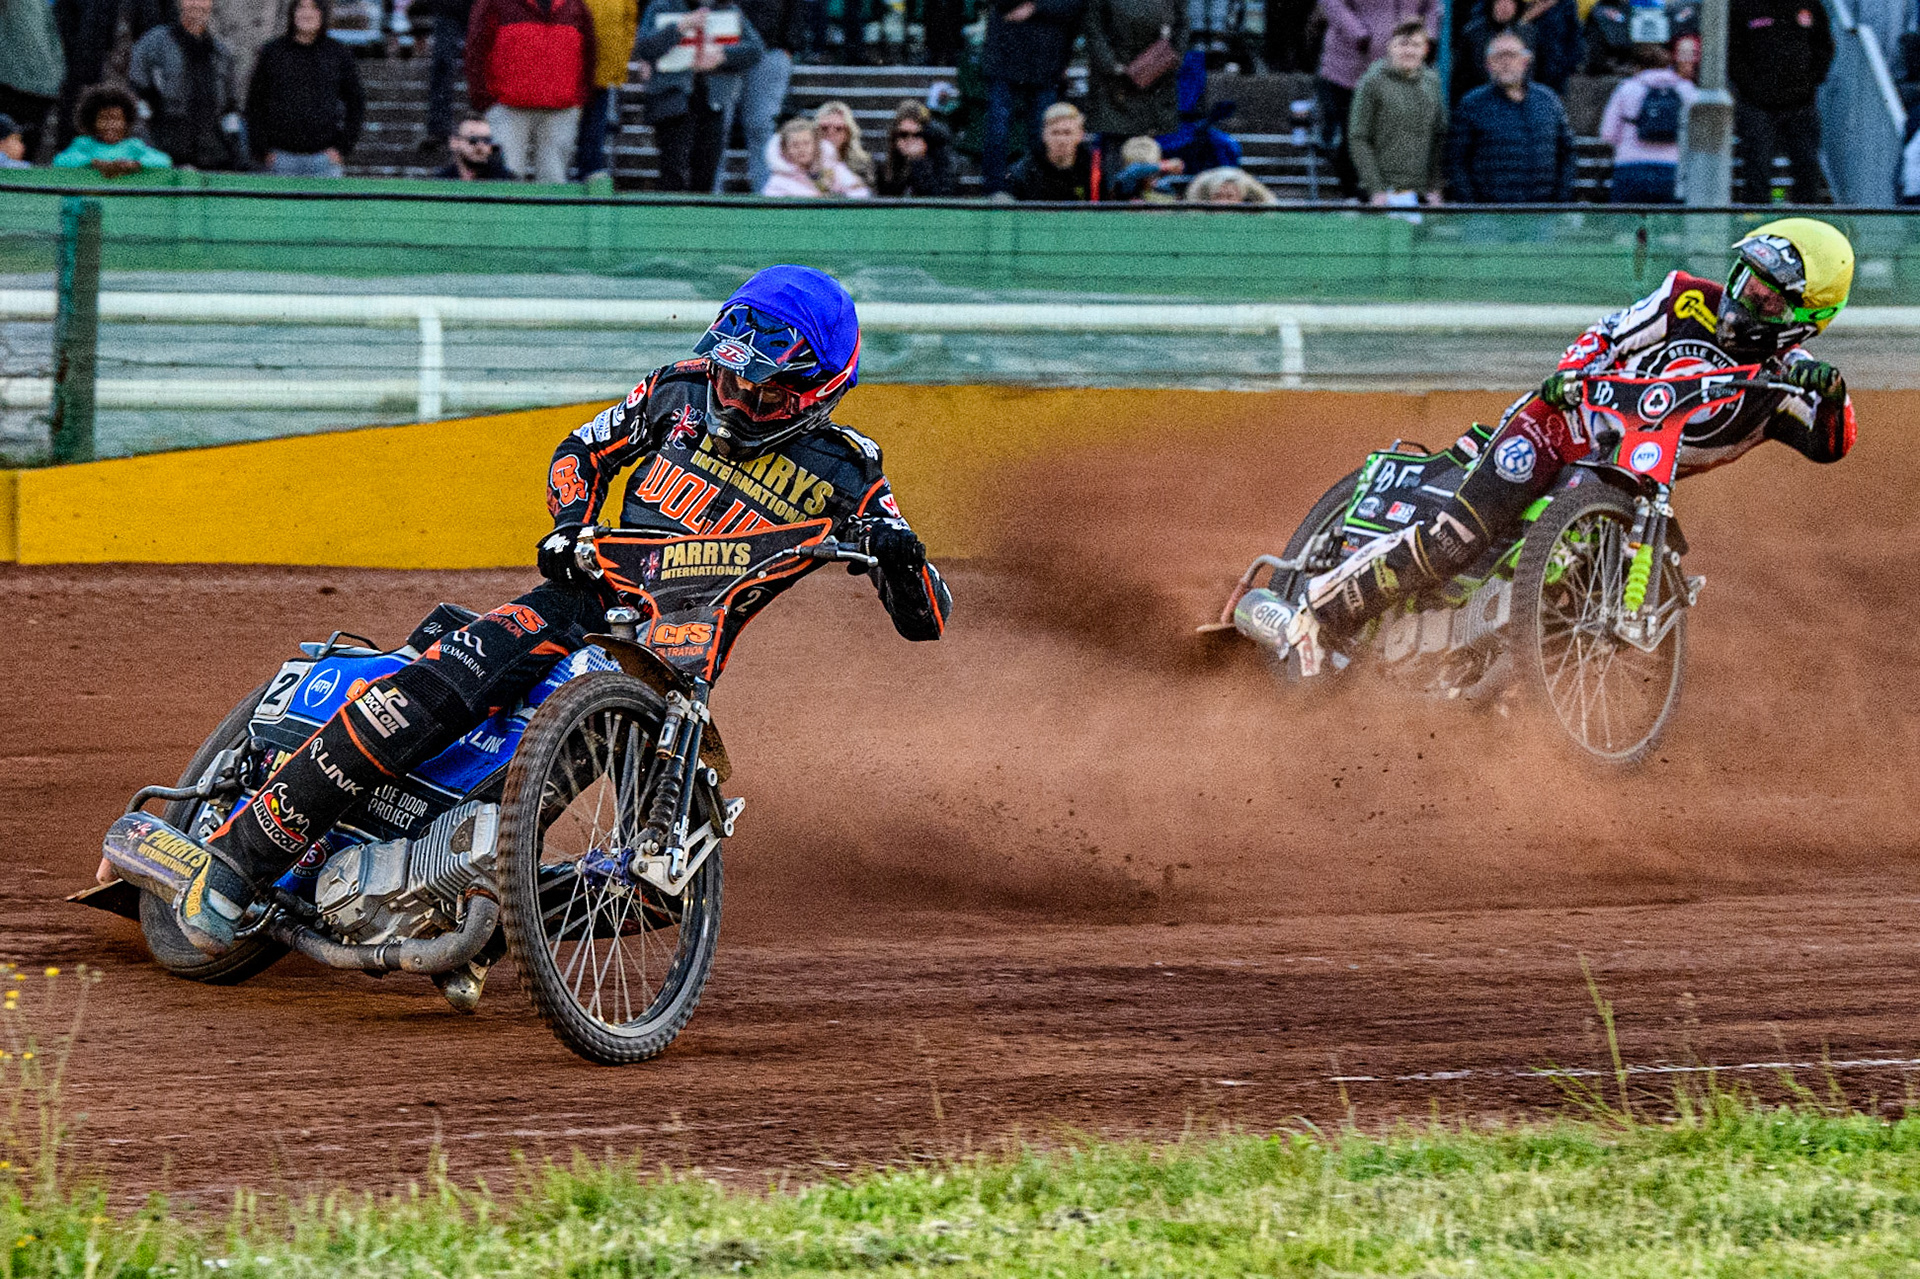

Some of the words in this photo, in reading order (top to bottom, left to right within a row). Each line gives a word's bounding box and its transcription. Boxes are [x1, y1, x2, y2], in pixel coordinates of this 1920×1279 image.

[715, 344, 748, 363] STS
[1669, 346, 1708, 360] BELLE
[1712, 354, 1730, 369] VU
[690, 450, 812, 524] INTERNATIONA
[661, 541, 752, 569] PARRYS
[734, 589, 762, 613] 2
[653, 622, 714, 646] CFS
[262, 673, 300, 706] 2
[310, 679, 333, 695] ATPI
[362, 692, 382, 718] ROCK
[379, 713, 401, 735] OIL
[469, 730, 507, 754] LINK
[317, 752, 364, 796] LINK
[368, 798, 416, 830] PROJECT
[371, 784, 400, 804] LUE
[397, 792, 428, 817] DOOR
[144, 829, 210, 868] PARRYS
